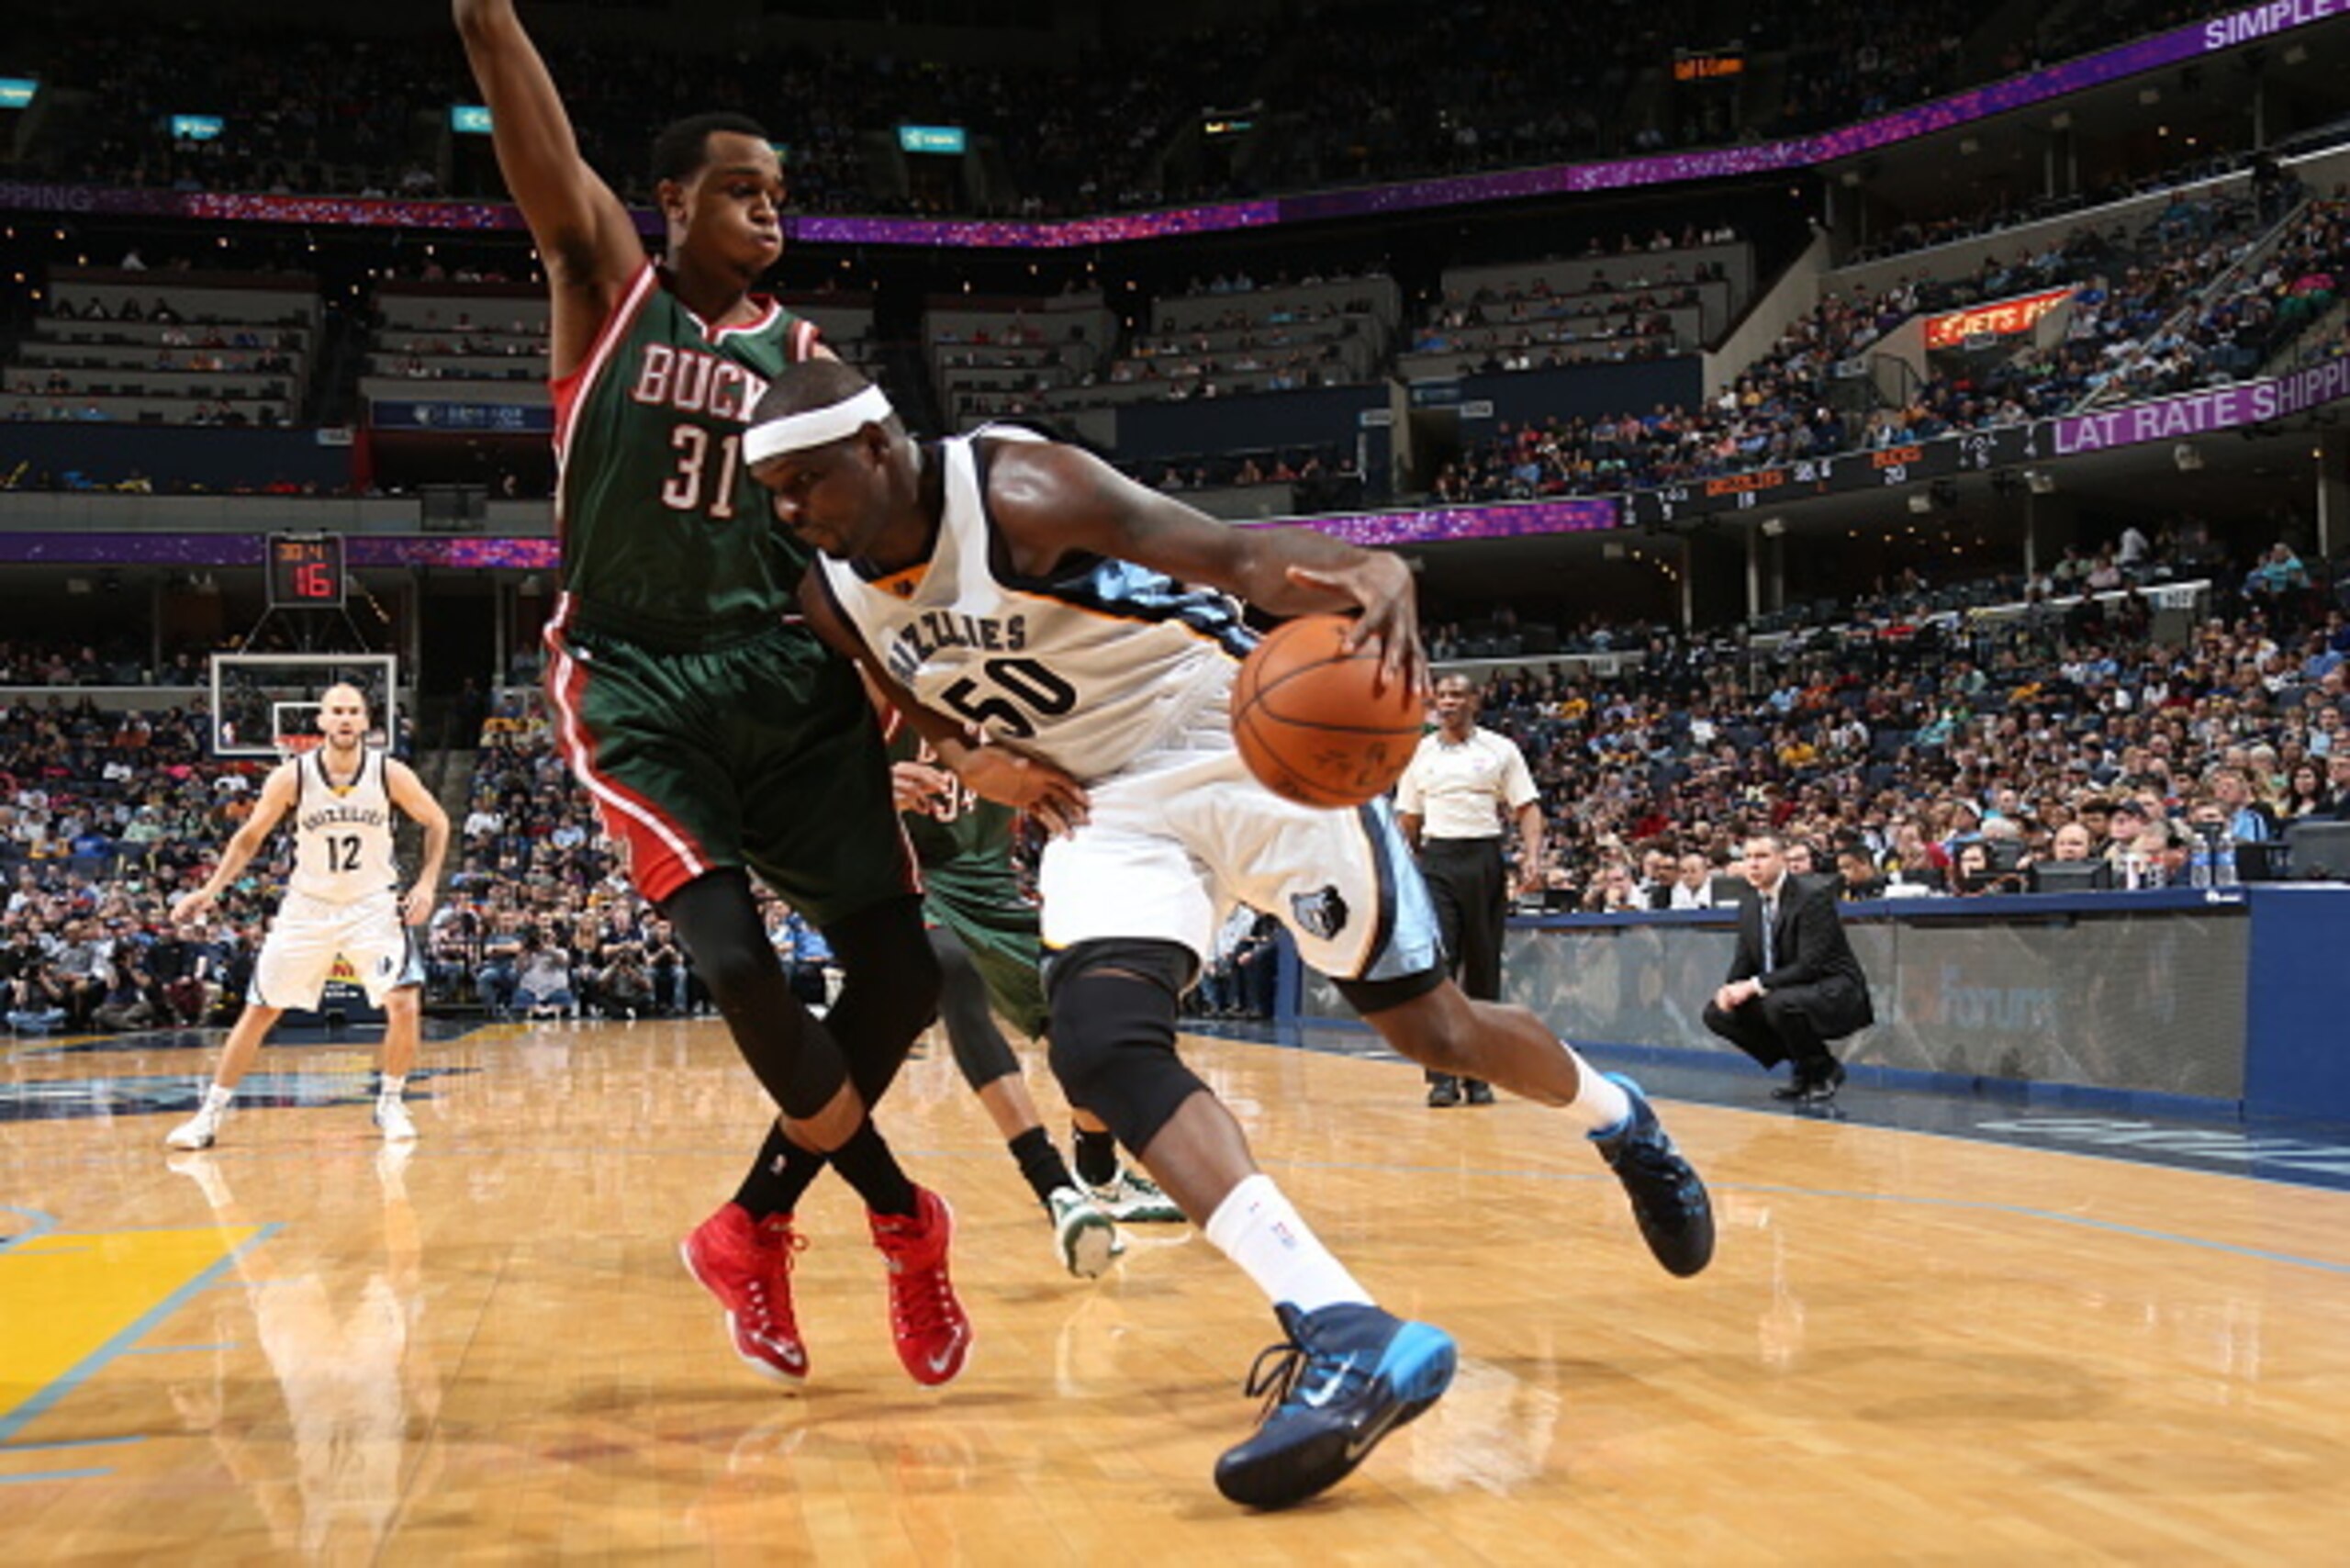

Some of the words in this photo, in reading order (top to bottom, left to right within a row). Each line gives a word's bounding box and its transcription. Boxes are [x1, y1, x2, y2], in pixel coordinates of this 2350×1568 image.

[2205, 0, 2335, 49] SIMPLE
[2054, 411, 2121, 454] LAT
[2134, 392, 2237, 442] RATE
[661, 424, 740, 519] 31
[296, 562, 334, 597] 16
[941, 658, 1076, 738] 50
[326, 834, 363, 873] 12
